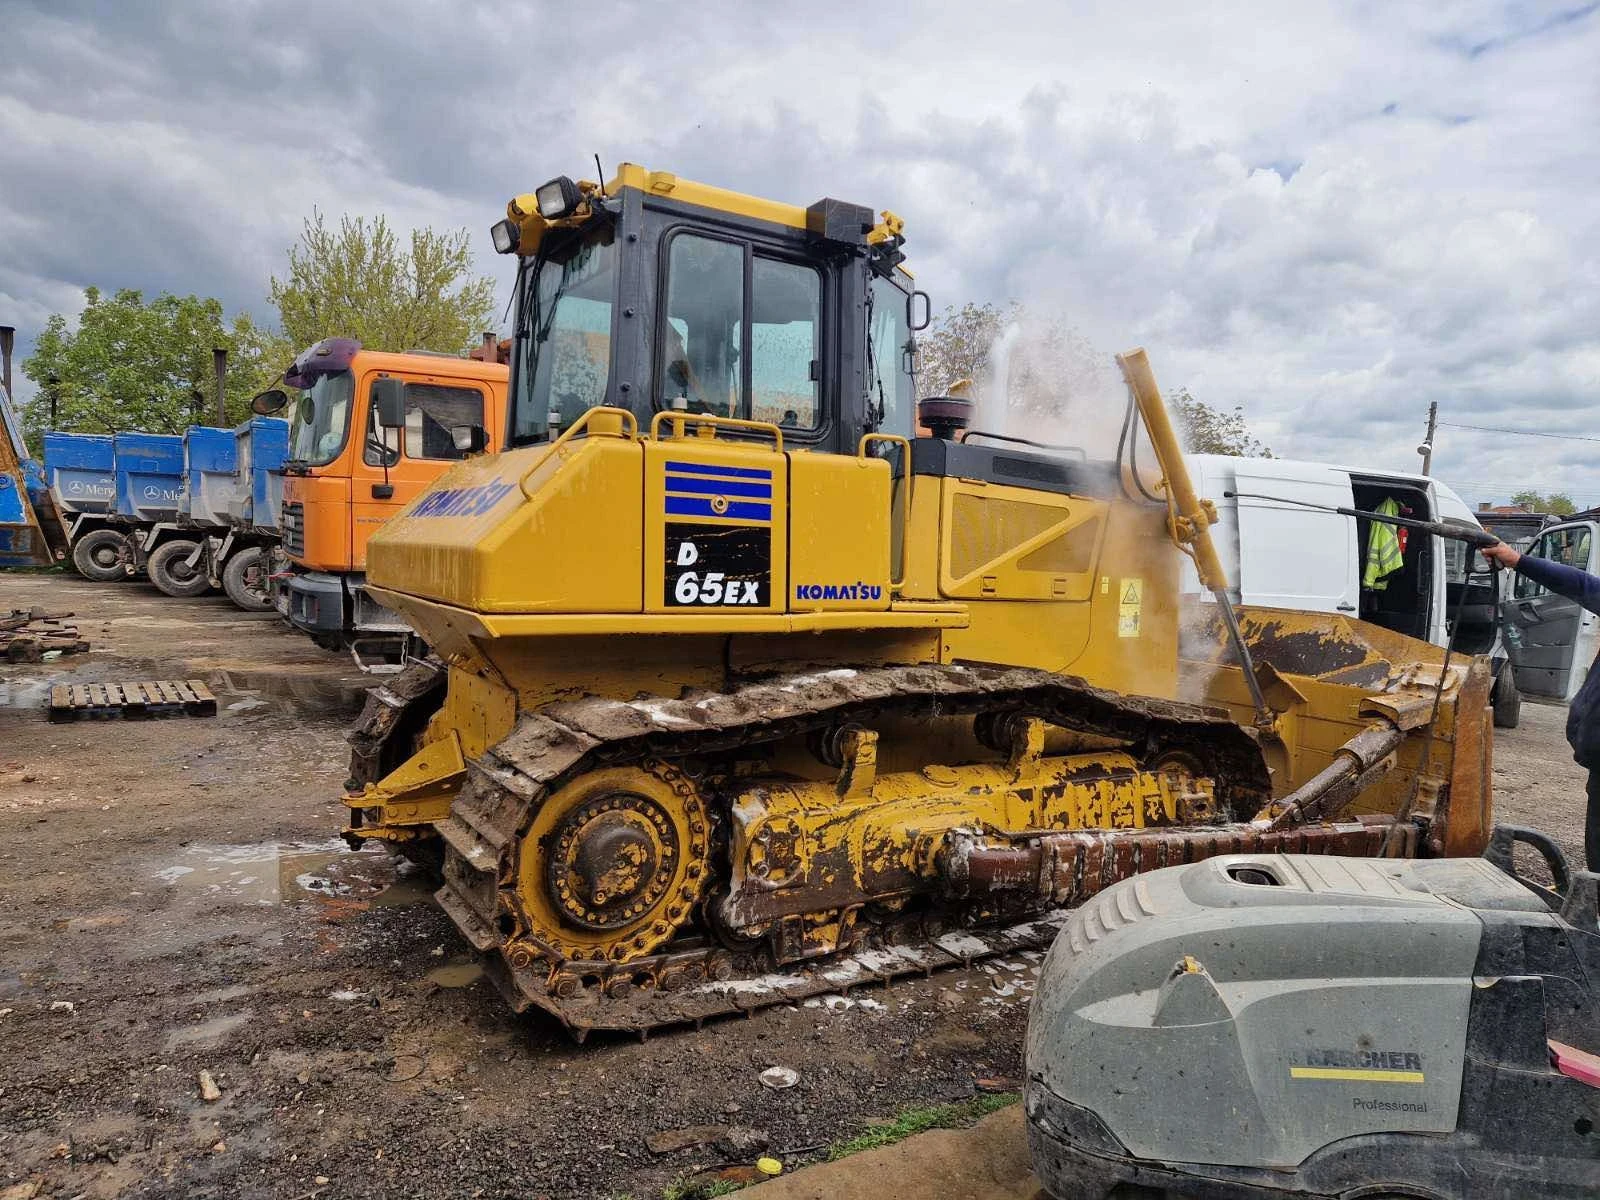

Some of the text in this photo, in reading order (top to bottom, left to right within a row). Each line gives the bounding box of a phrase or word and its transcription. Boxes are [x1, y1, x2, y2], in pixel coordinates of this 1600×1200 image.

[676, 542, 698, 566] D
[675, 572, 759, 604] 65EX
[797, 581, 881, 600] KOMATSU
[1352, 1098, 1427, 1112] Professional
